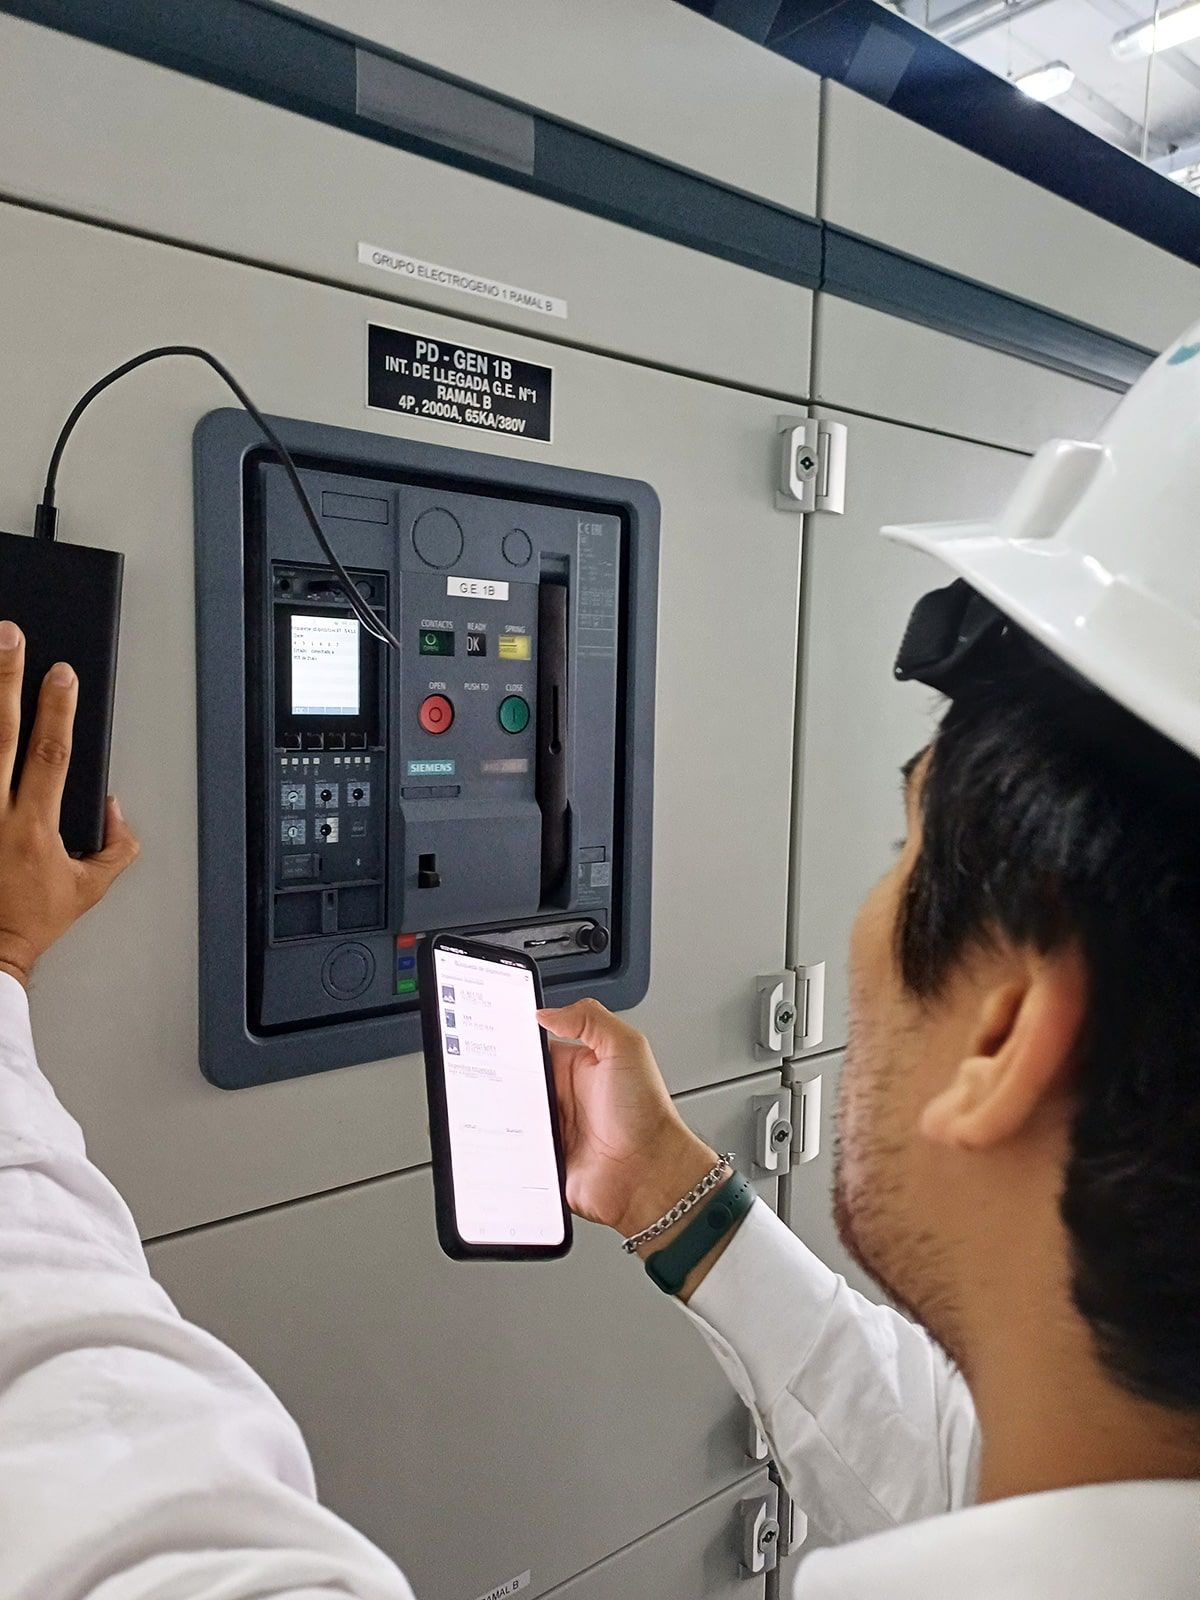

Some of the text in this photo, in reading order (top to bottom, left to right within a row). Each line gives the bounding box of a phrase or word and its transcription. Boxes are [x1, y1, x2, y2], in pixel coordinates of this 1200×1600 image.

[372, 251, 415, 274] GRUPO
[417, 265, 499, 297] ELECTROGENO
[509, 290, 543, 310] RAMAL
[545, 300, 553, 312] B
[415, 340, 439, 363] PD
[453, 350, 488, 375] GEN
[492, 359, 512, 380] 1B
[385, 355, 409, 375] INT.
[412, 361, 431, 379] DE
[433, 366, 491, 393] LLEGADA
[492, 381, 516, 399] G.E.
[437, 385, 492, 410] RAMAL B
[421, 399, 463, 423] 2000A,
[465, 409, 527, 433] 65KA/380V
[483, 585, 495, 596] 1B
[428, 681, 447, 690] OPEN
[463, 682, 490, 691] PUSH TO
[505, 683, 524, 692] CLOSE
[410, 763, 453, 773] SIEMENS
[512, 1580, 519, 1590] B
